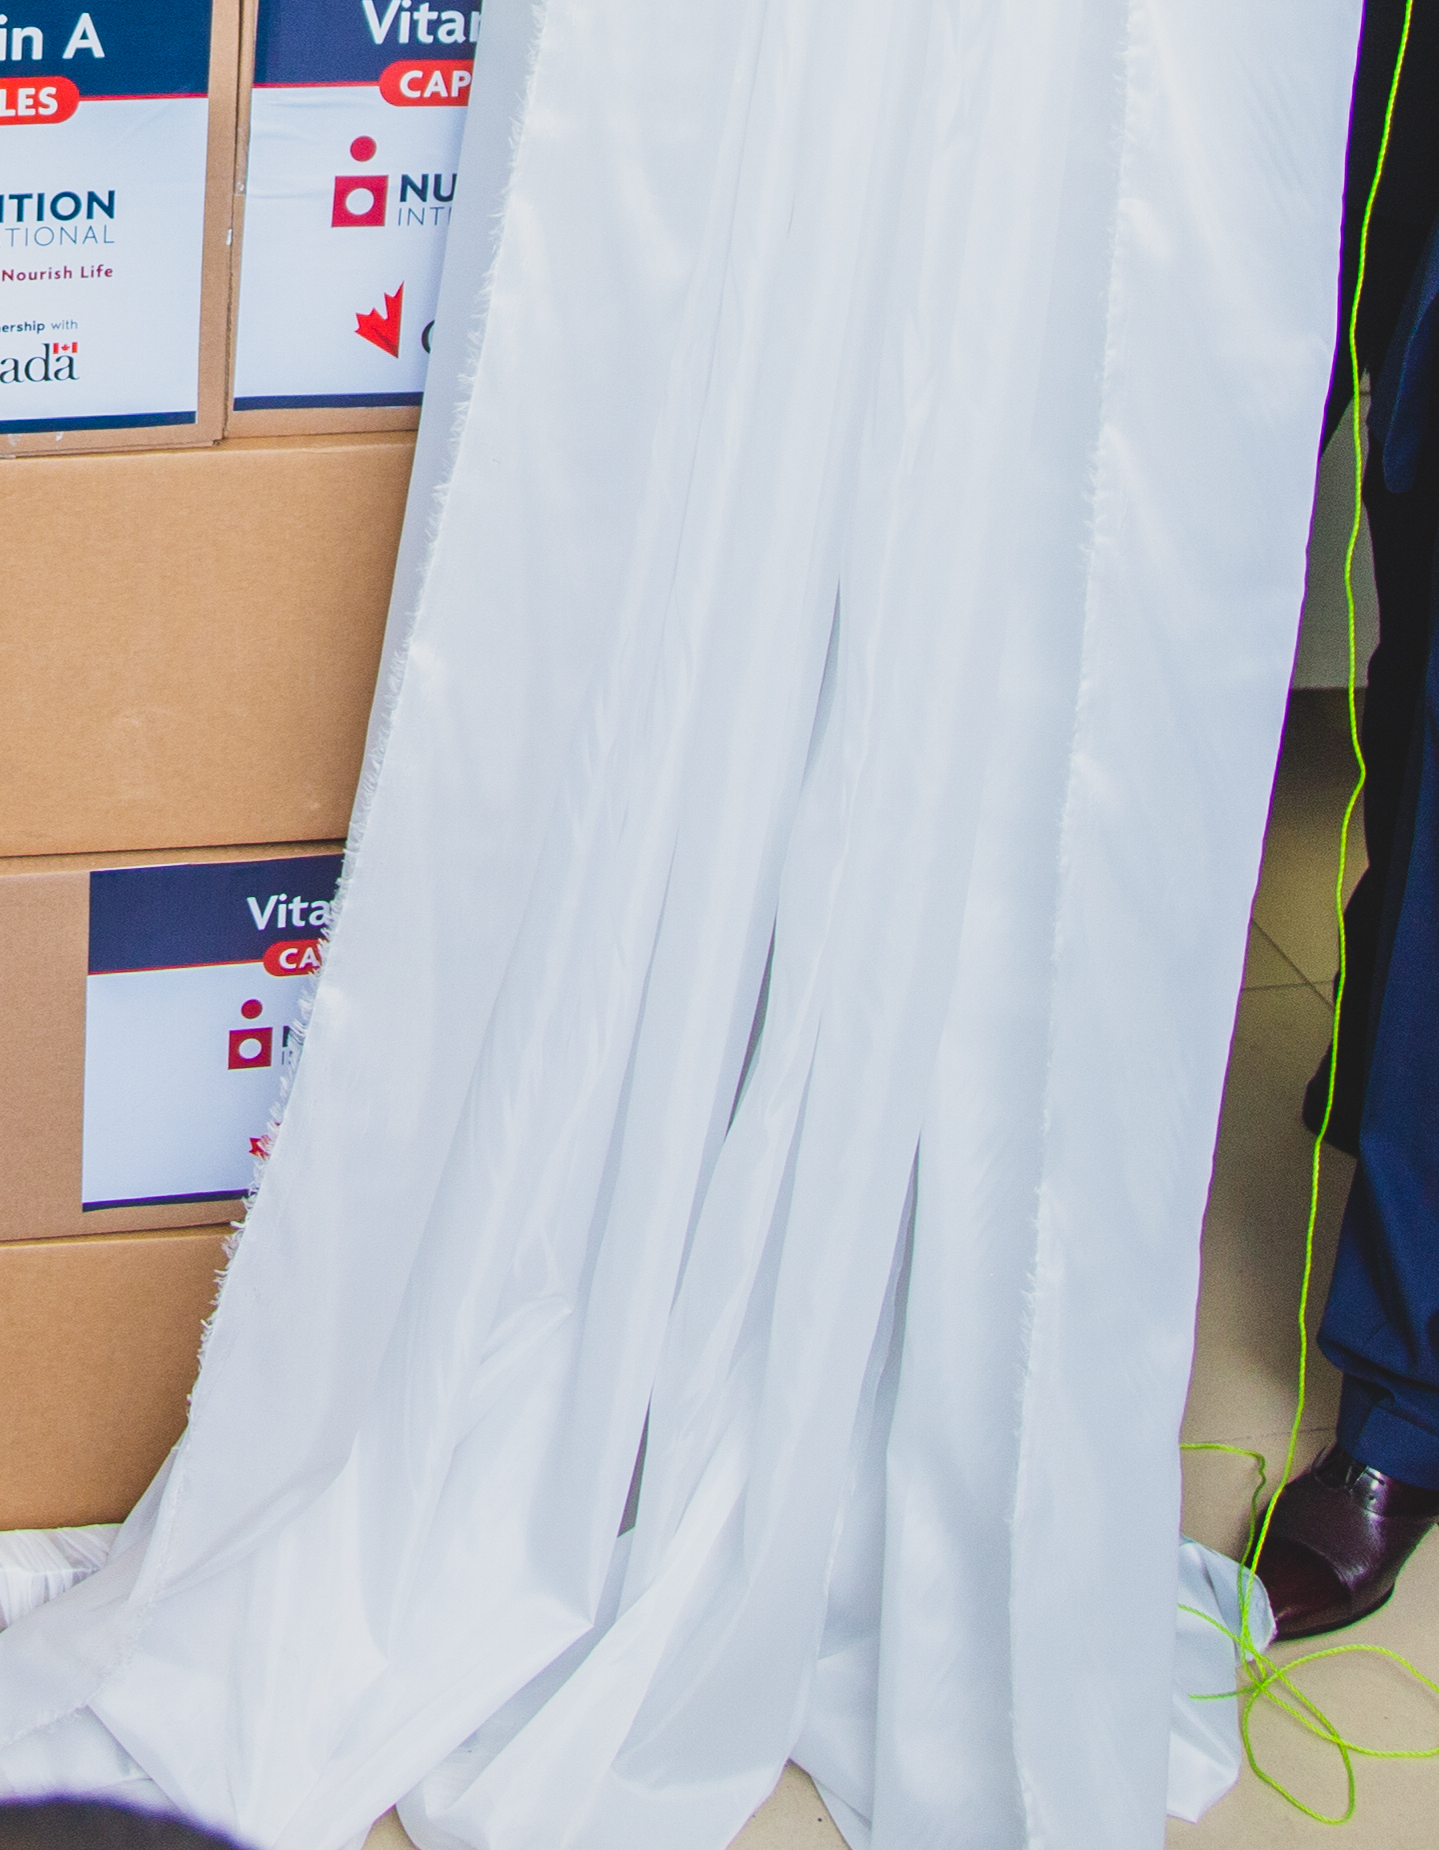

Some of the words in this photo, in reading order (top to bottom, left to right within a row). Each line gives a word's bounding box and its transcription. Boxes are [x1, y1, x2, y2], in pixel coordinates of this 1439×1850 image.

[63, 13, 105, 59] A
[2, 266, 72, 281] Nourish
[81, 264, 113, 278] Life
[50, 319, 78, 331] with
[246, 893, 331, 931] Vita
